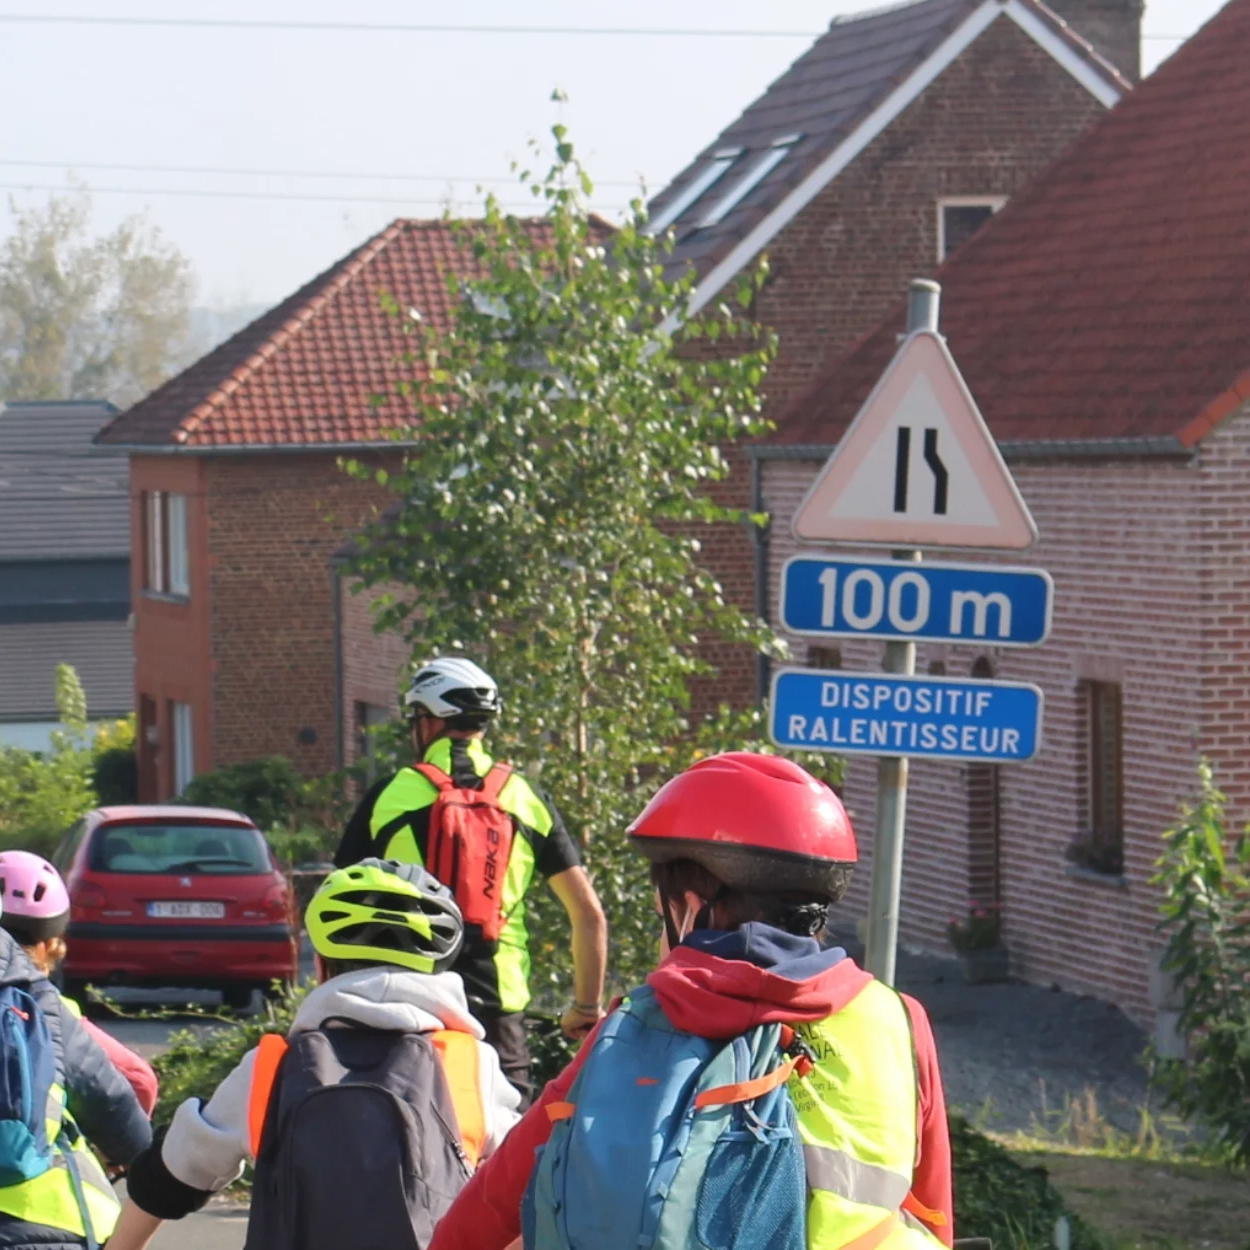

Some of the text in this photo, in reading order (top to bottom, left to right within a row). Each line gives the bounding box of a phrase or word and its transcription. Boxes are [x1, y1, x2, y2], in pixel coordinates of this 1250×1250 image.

[818, 567, 1012, 637] 100 m
[821, 682, 992, 716] DISPOSITIF
[788, 715, 1020, 753] RALENTISSEUR
